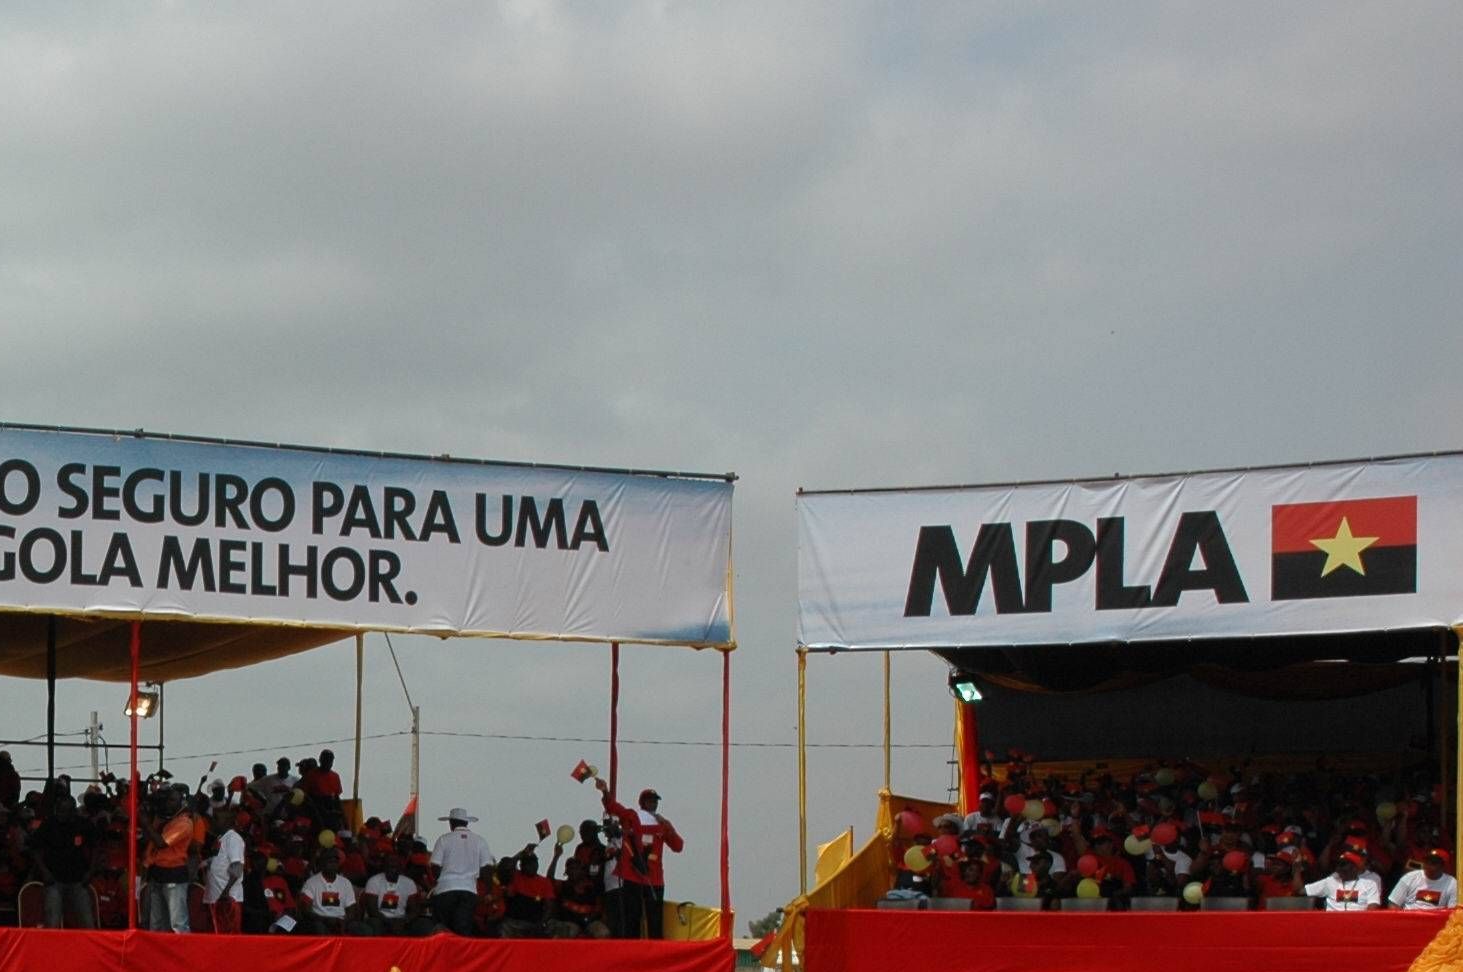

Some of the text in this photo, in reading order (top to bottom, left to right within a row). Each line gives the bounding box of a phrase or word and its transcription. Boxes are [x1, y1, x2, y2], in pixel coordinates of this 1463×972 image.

[57, 463, 295, 532] SEGURO
[312, 481, 461, 544] PARA
[476, 493, 609, 552] UMA
[157, 536, 418, 605] MELHOR.
[904, 511, 1249, 617] MPLA
